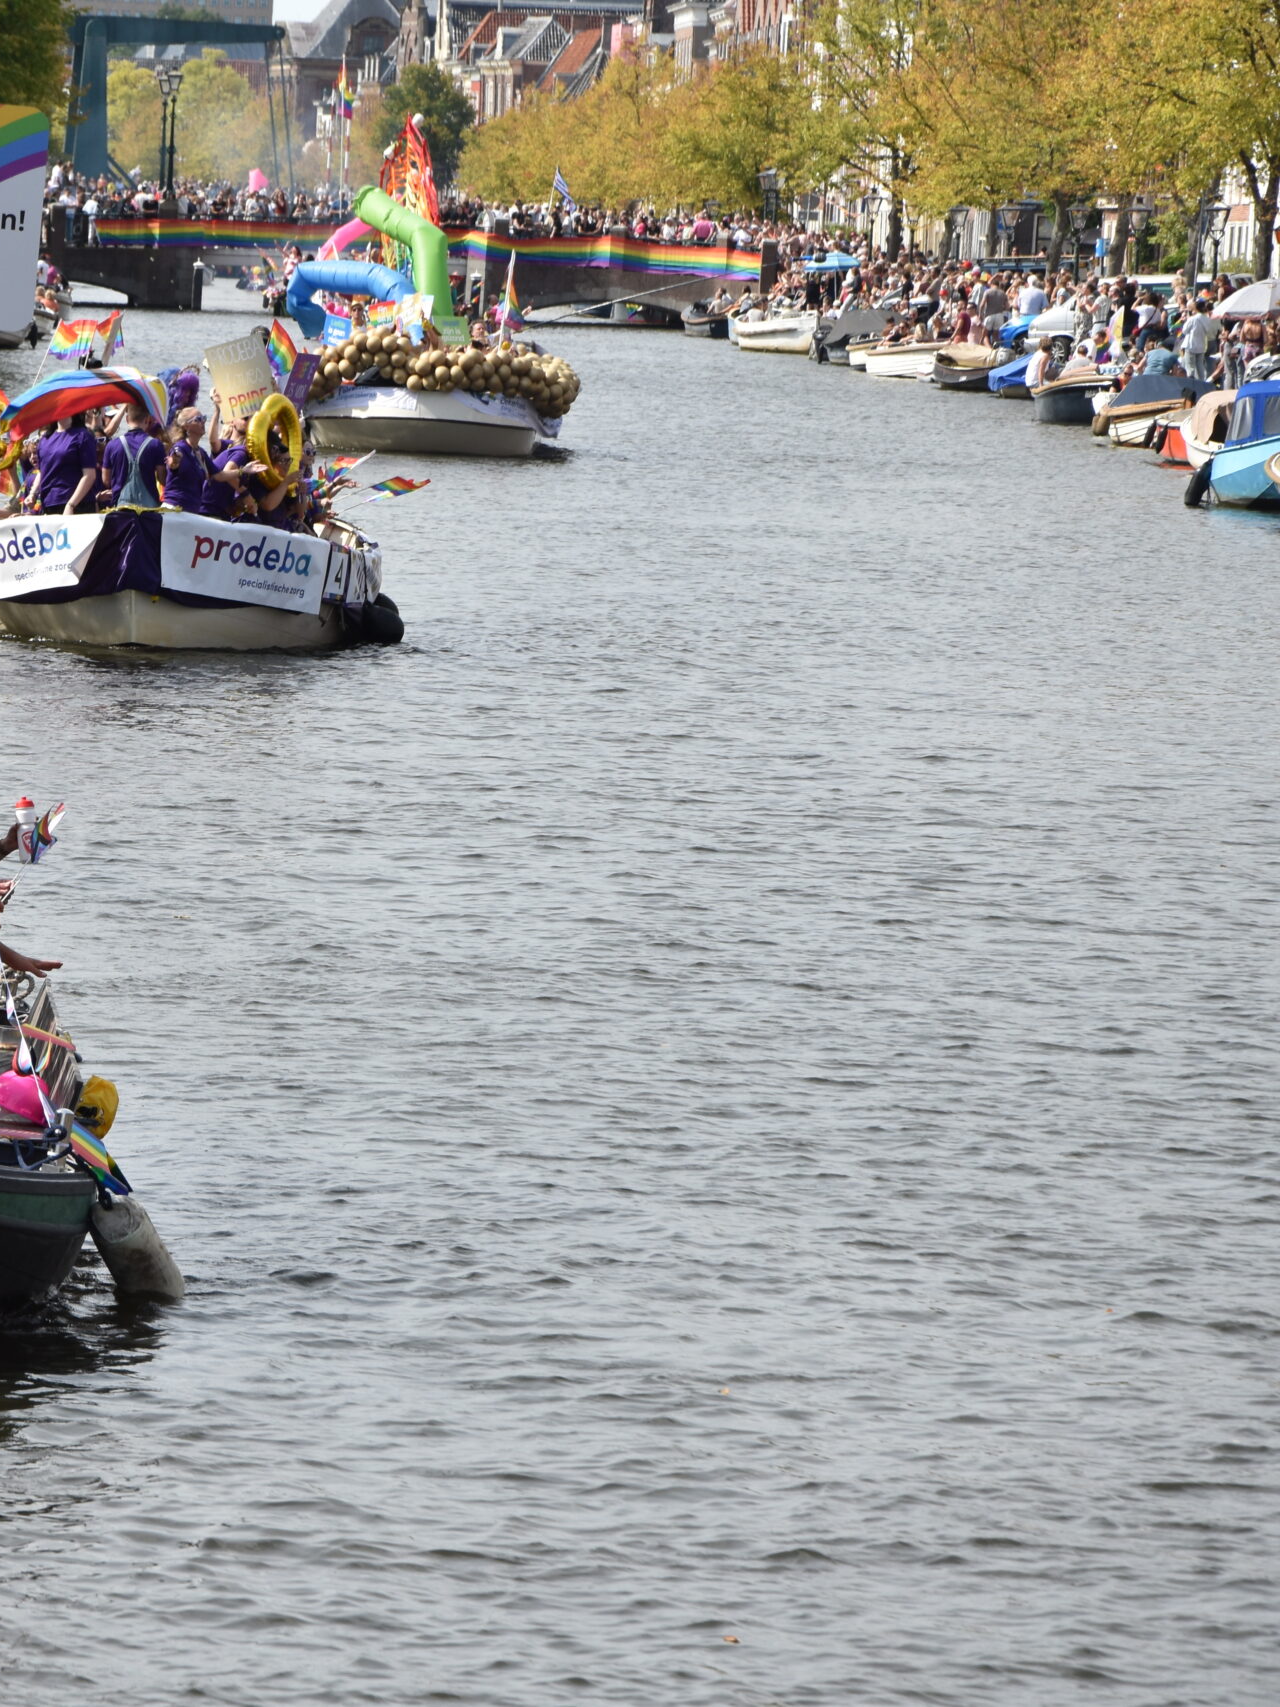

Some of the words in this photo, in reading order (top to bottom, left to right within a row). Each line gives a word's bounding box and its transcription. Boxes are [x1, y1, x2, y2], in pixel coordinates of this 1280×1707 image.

[191, 535, 312, 577] prodeba
[238, 577, 290, 594] specialistische
[290, 586, 305, 599] zorg
[334, 559, 344, 590] 4
